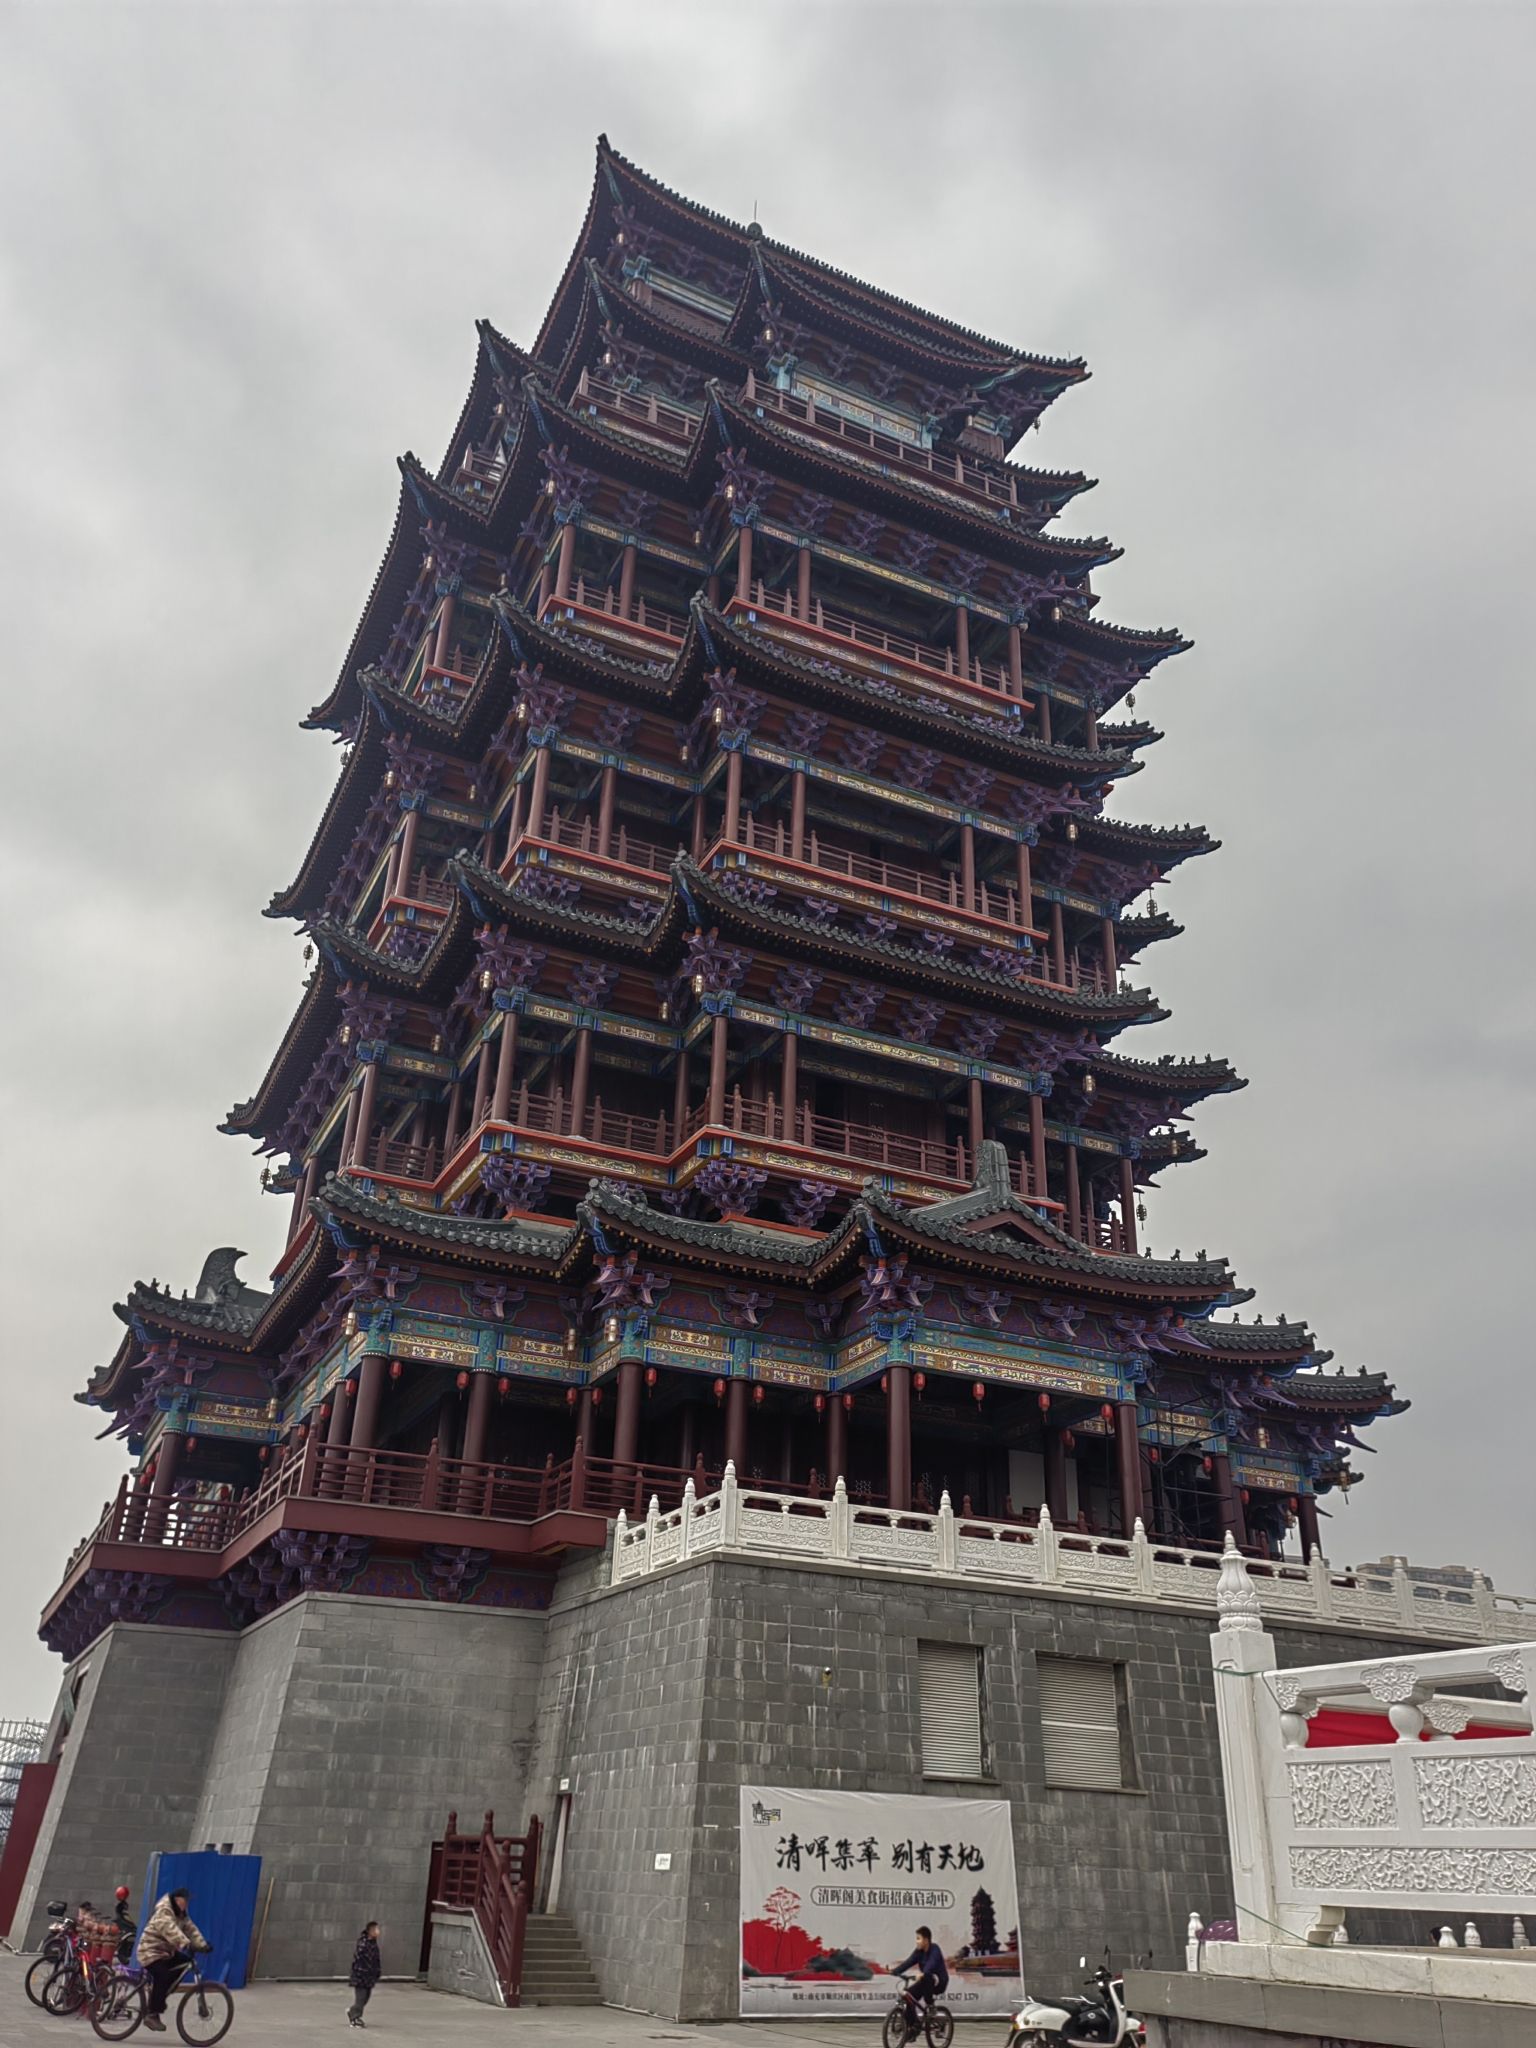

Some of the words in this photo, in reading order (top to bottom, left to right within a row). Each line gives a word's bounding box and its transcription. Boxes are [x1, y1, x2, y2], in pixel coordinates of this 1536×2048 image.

[775, 1833, 881, 1873] 清晖集萃
[891, 1839, 984, 1873] 别有天地
[818, 1888, 948, 1906] 清晖阁美食街招商启动中
